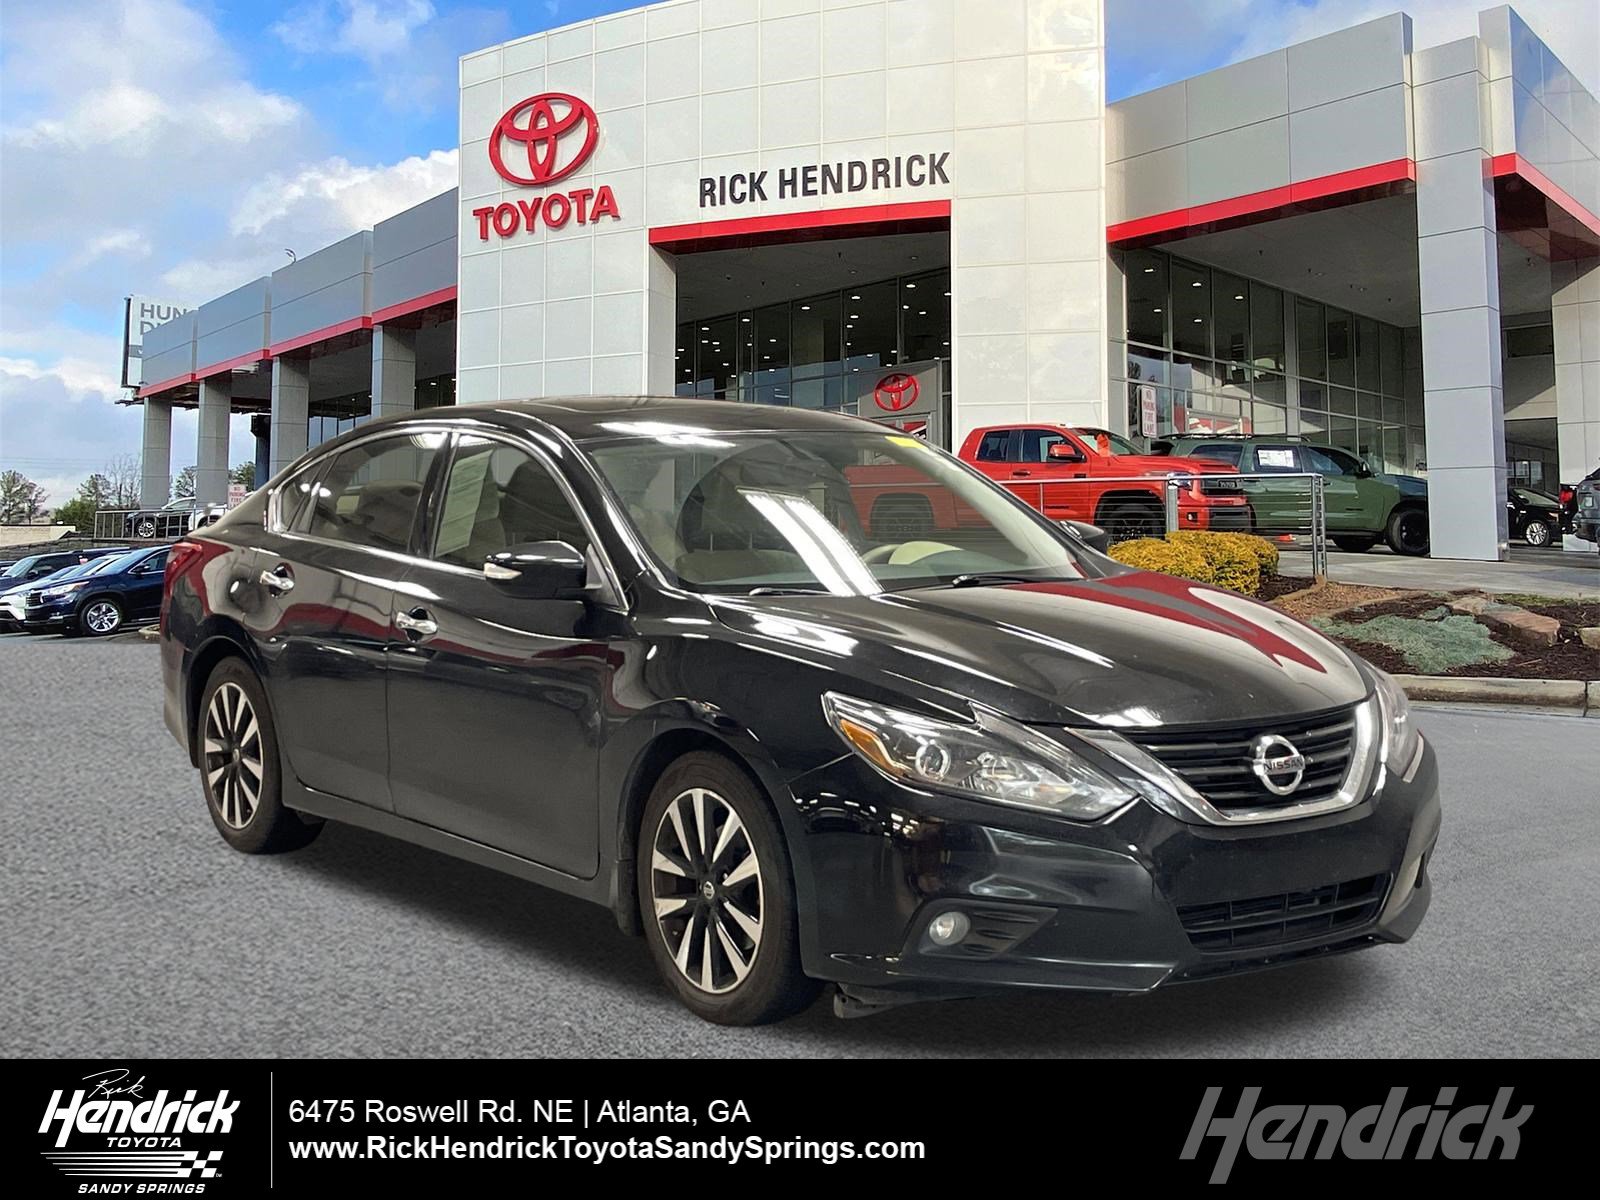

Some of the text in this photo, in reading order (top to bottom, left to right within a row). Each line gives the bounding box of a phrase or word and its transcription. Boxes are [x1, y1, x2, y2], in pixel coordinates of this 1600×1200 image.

[699, 151, 951, 208] RICK HENDRICK
[473, 185, 621, 241] TOYOTA
[1263, 757, 1303, 770] NISSAN
